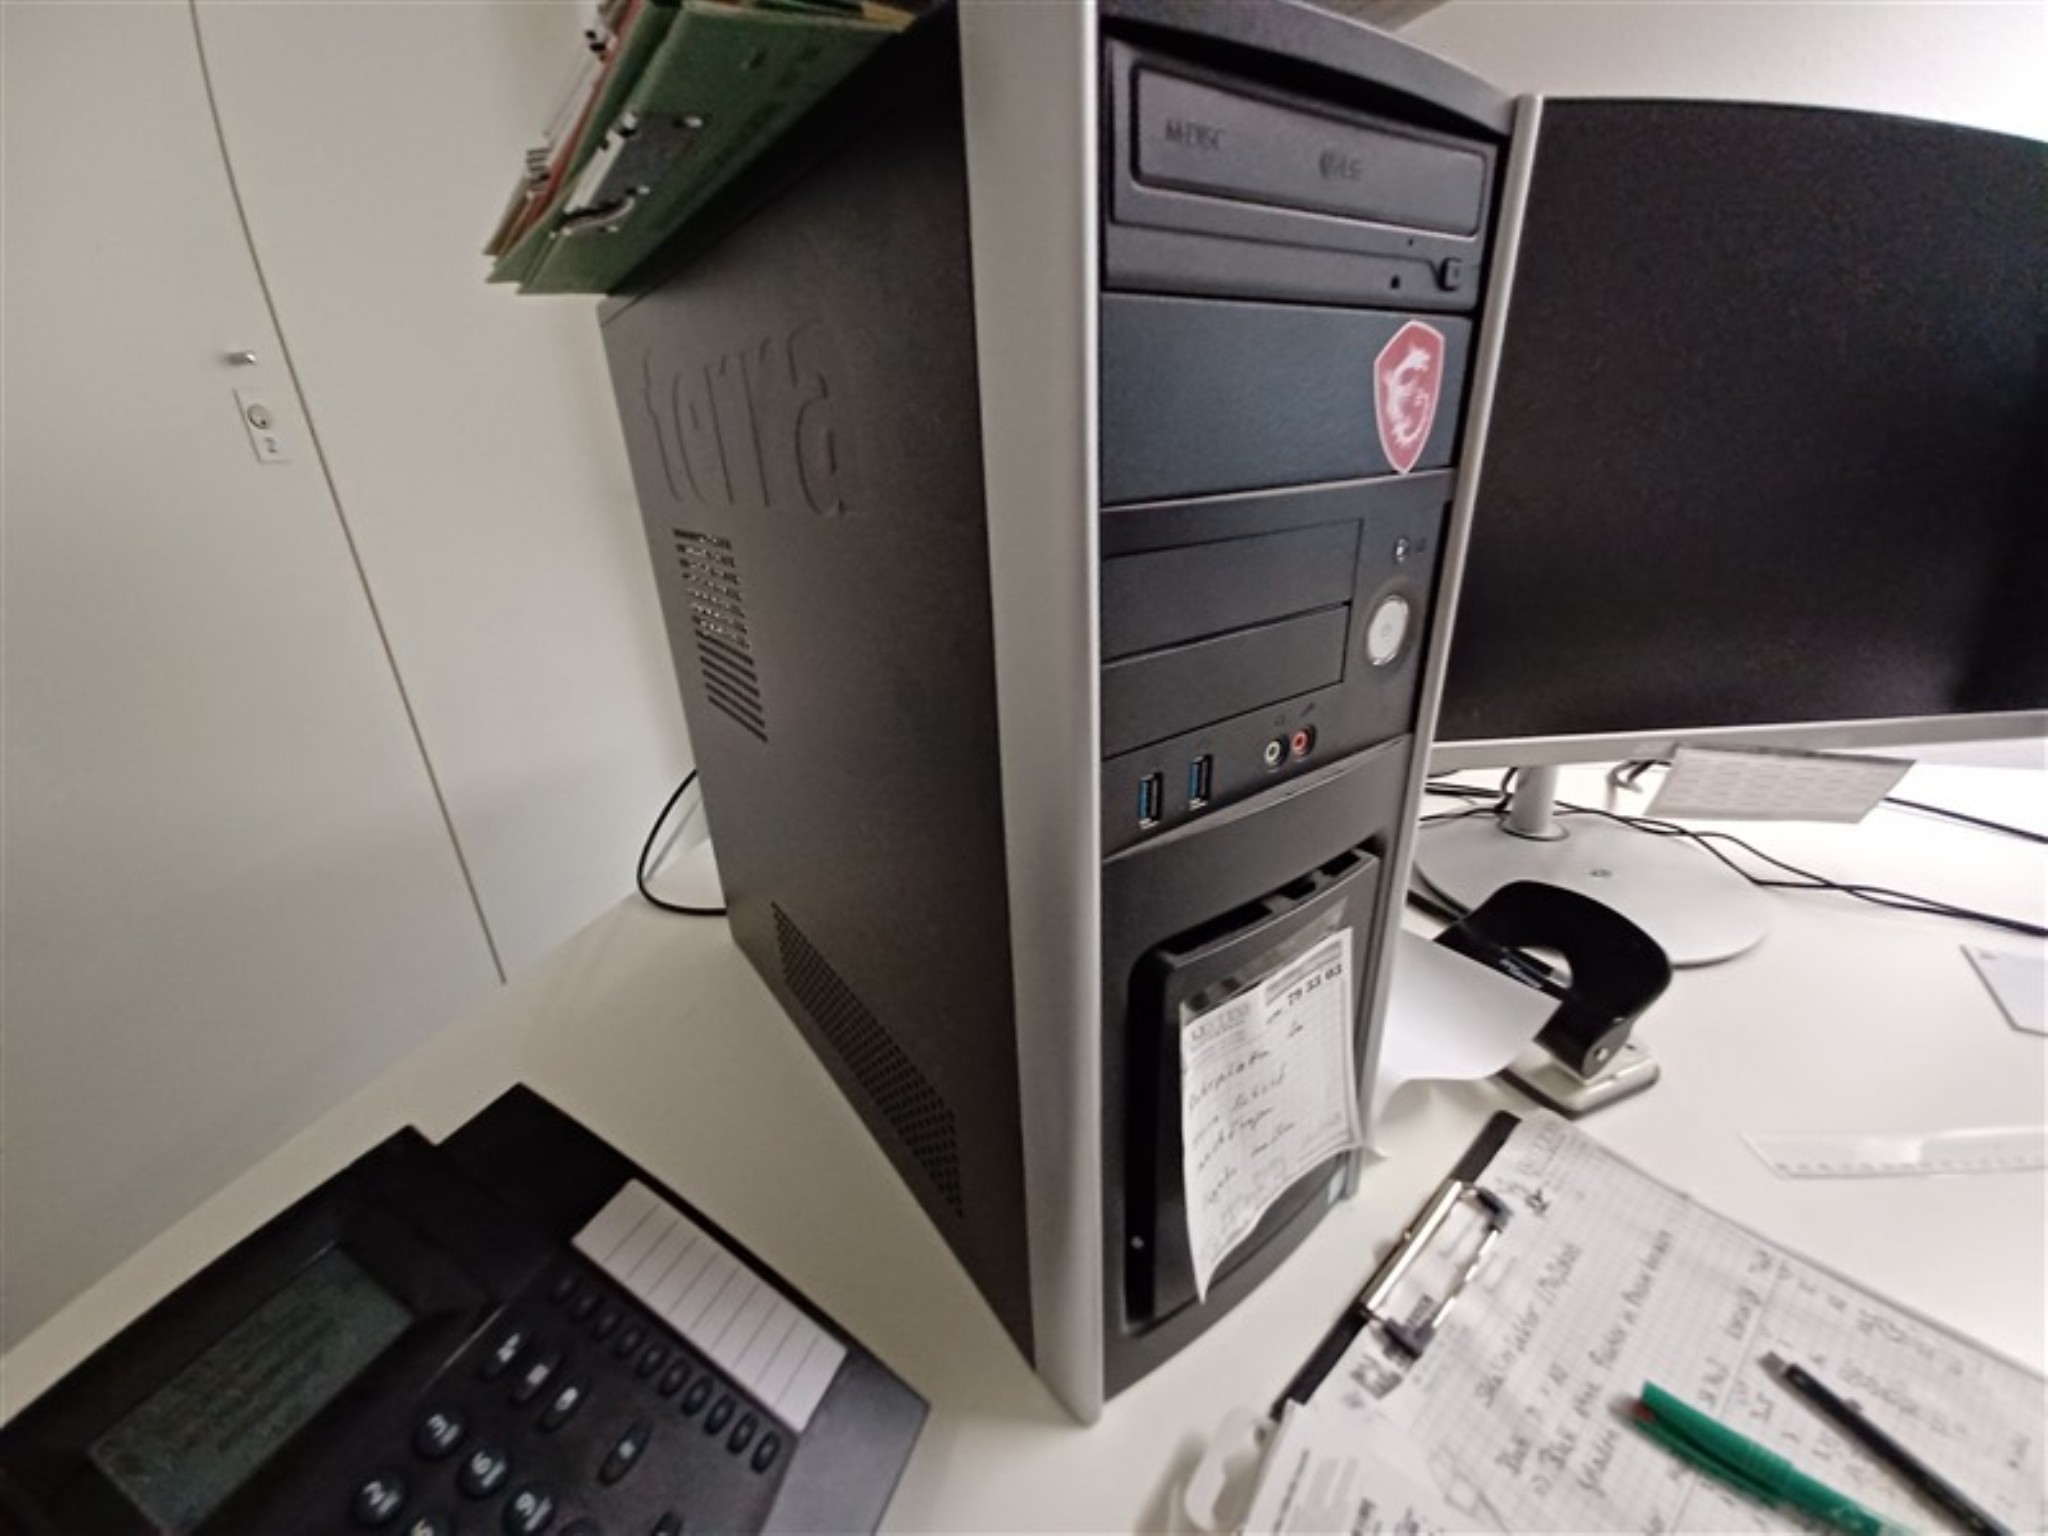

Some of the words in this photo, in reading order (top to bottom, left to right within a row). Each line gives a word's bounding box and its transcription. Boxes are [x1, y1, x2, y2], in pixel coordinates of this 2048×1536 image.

[641, 317, 852, 517] terra
[264, 436, 279, 454] 2
[428, 1414, 449, 1439] 3
[471, 1451, 492, 1475] 6
[363, 1481, 386, 1506] 2
[515, 1492, 536, 1516] 9
